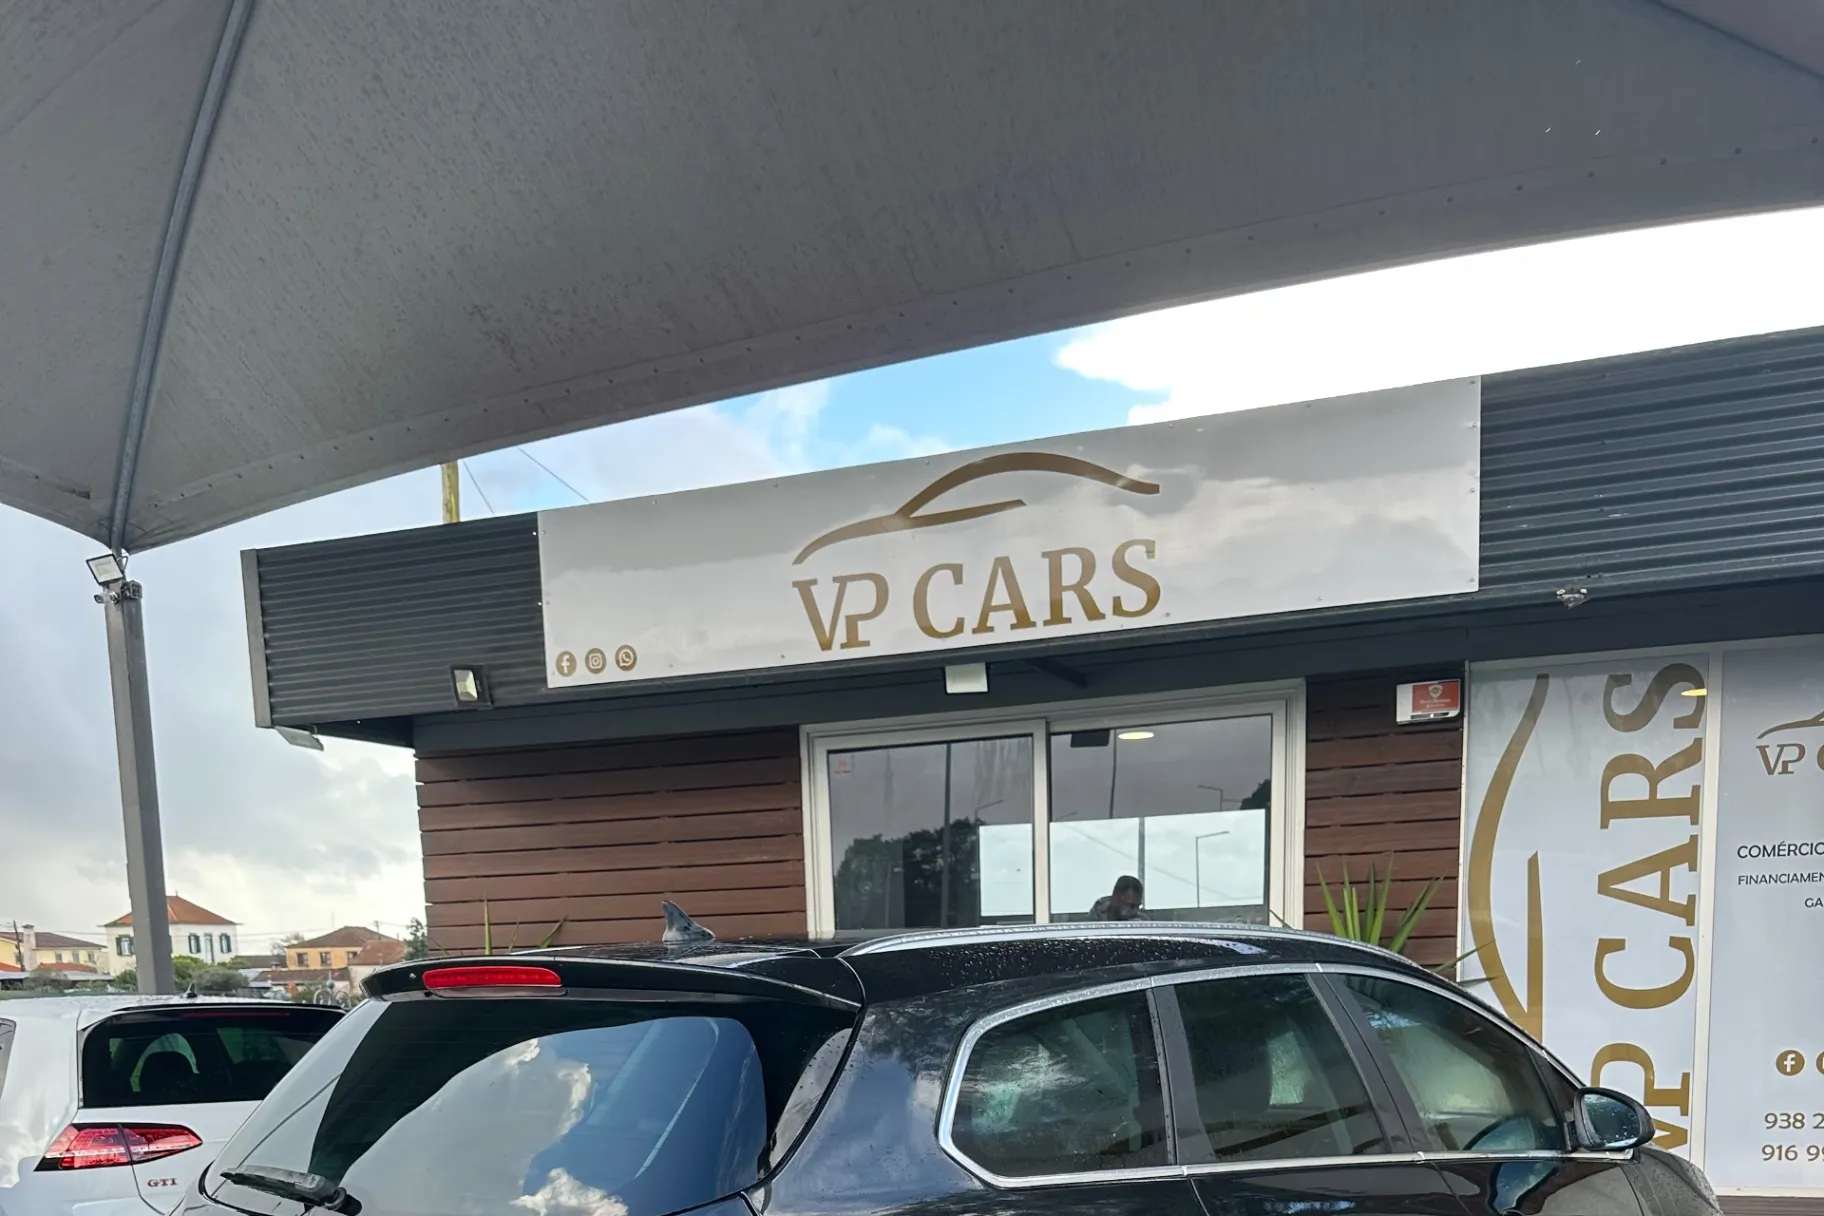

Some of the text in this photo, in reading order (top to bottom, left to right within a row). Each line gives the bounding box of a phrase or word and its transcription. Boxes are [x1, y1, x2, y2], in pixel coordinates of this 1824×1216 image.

[792, 538, 1162, 652] VP CARS
[1755, 743, 1806, 776] VP
[1594, 663, 1706, 1010] CARS
[1764, 1112, 1805, 1130] 938
[1761, 1144, 1824, 1162] 916 9
[147, 1178, 178, 1188] GTI
